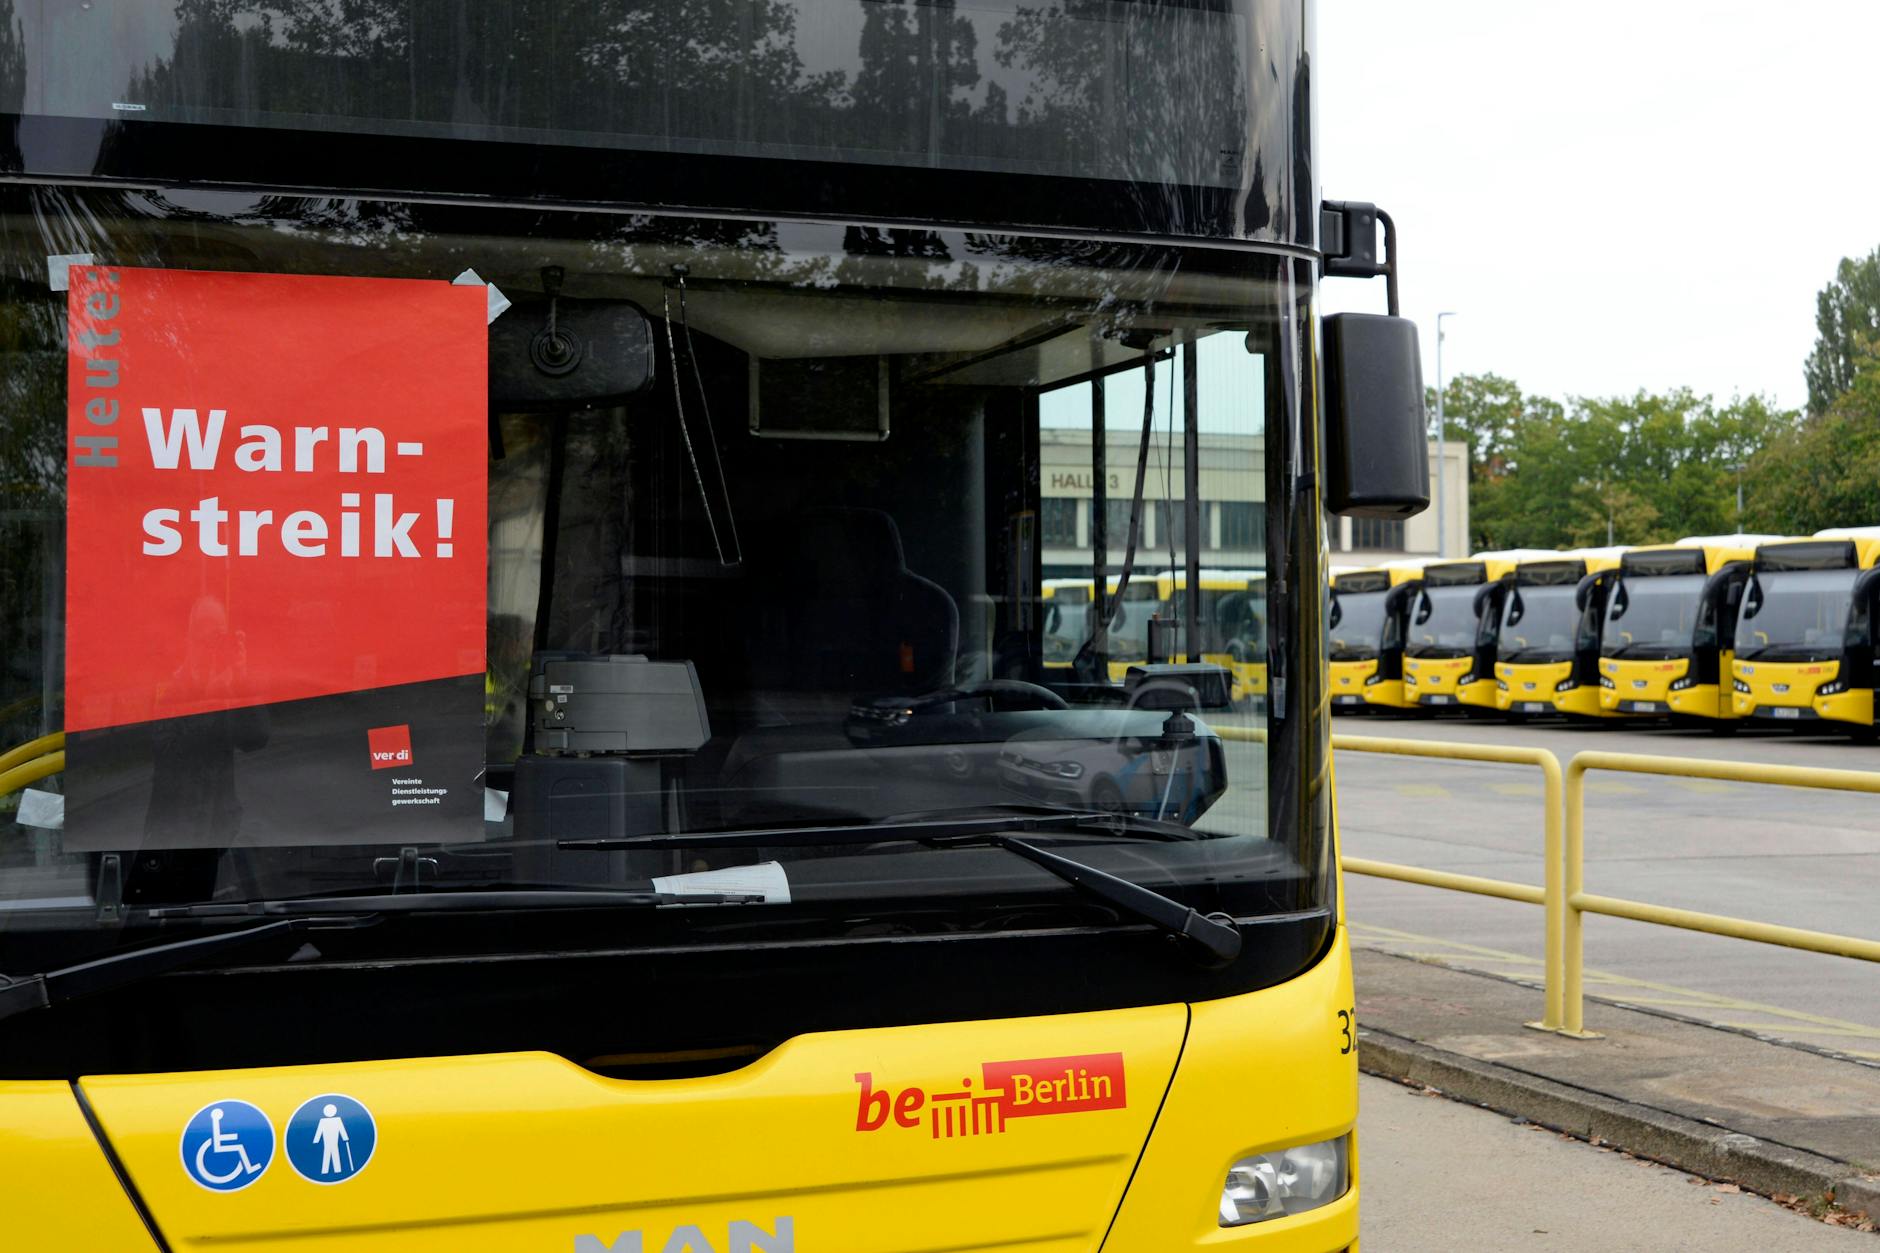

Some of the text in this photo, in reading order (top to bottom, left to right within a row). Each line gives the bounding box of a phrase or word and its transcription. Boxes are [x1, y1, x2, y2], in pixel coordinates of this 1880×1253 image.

[74, 271, 121, 468] Heute:
[142, 408, 423, 473] Warn-
[1051, 474, 1119, 489] HALL 3
[142, 493, 454, 558] streik!
[391, 778, 423, 786] Vereinte
[391, 797, 441, 806] gewerkschaft
[854, 1068, 1112, 1132] be Berlin
